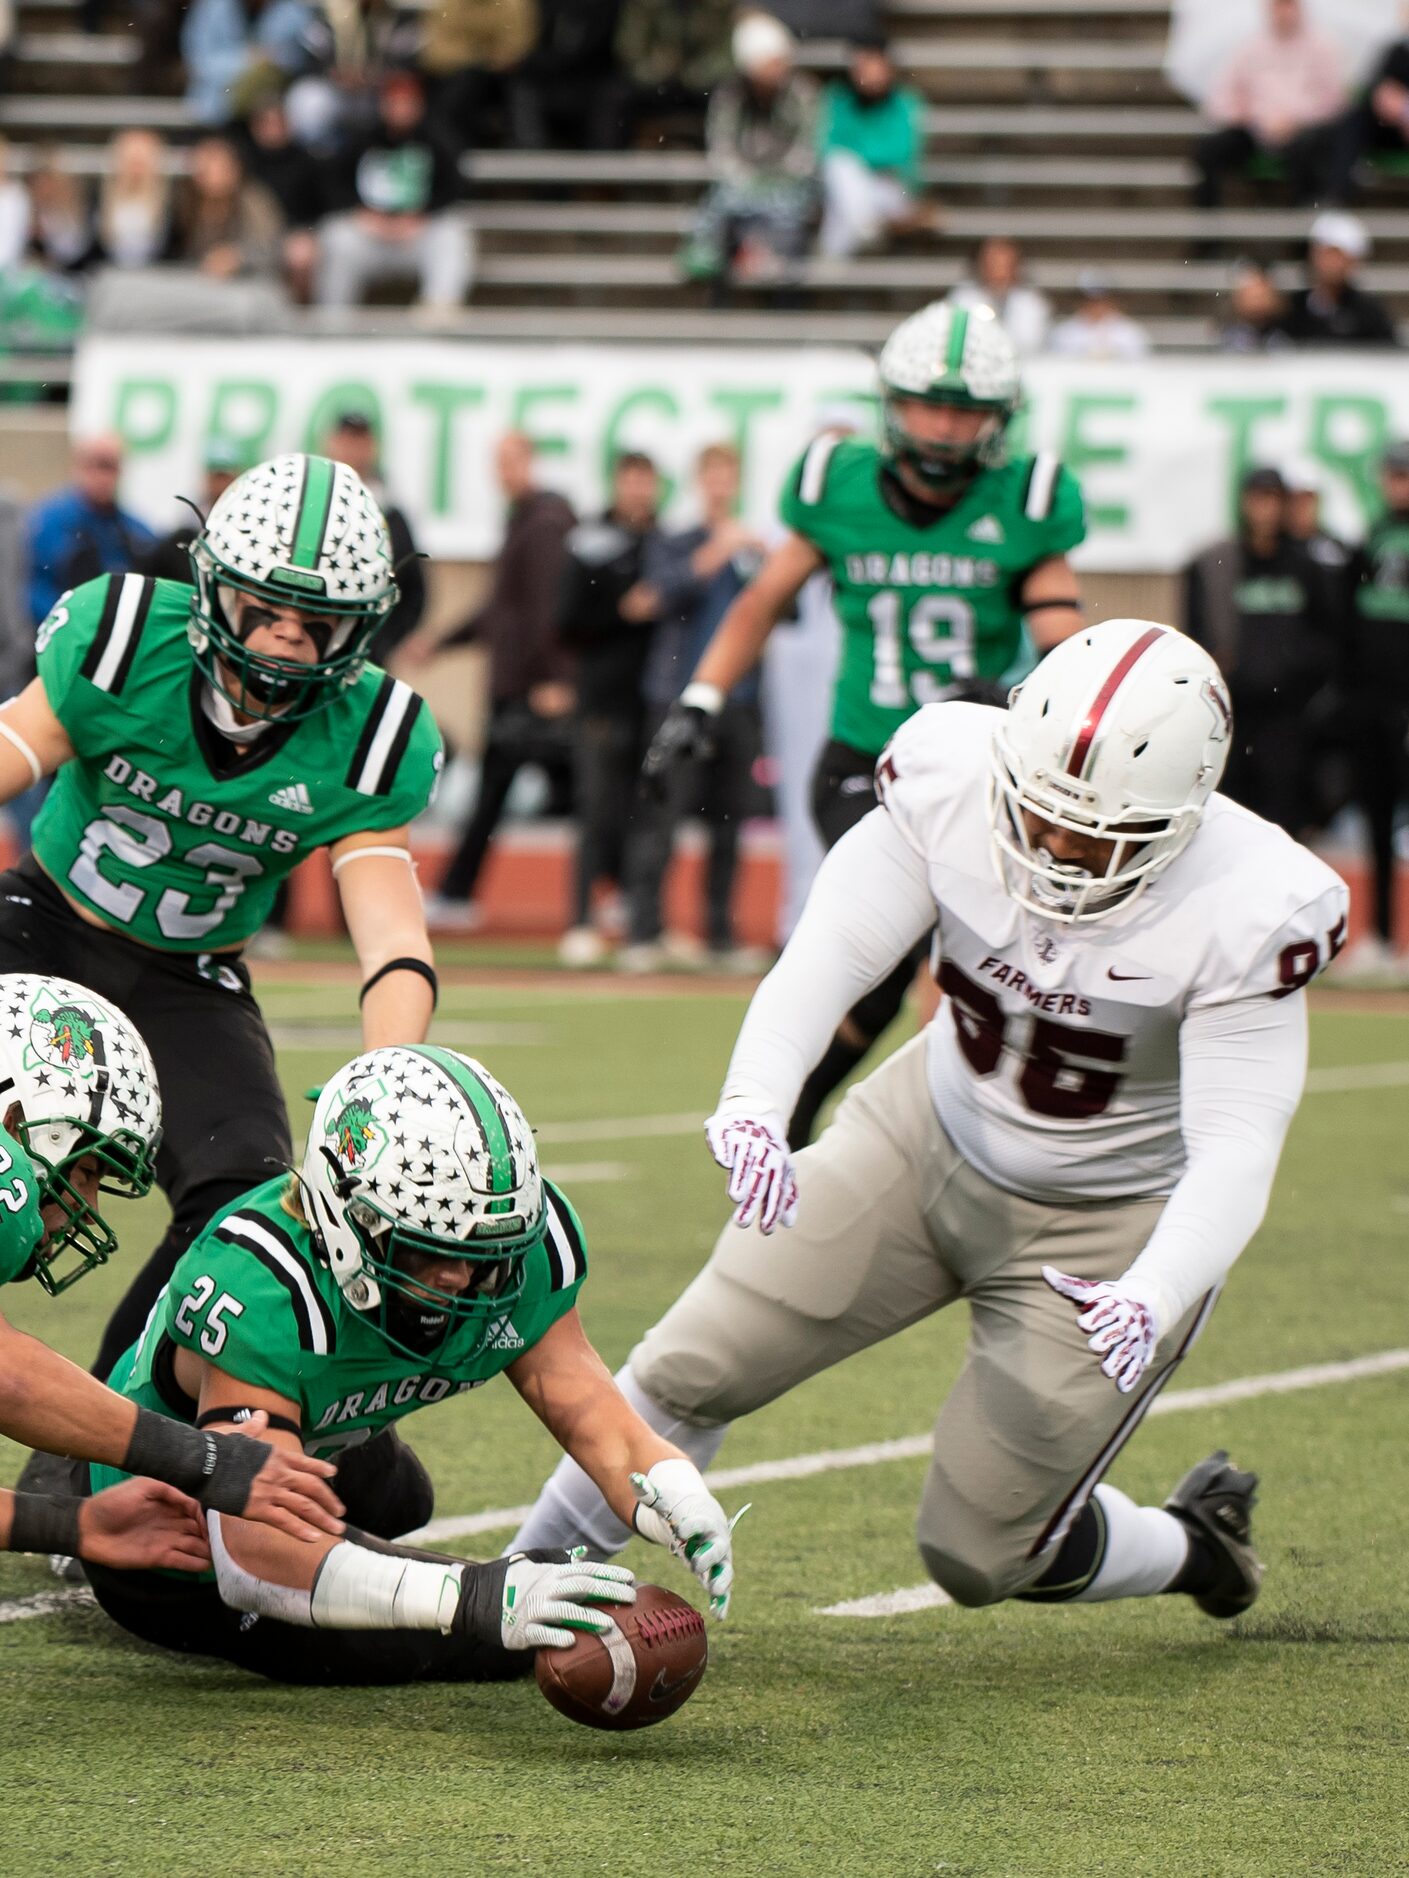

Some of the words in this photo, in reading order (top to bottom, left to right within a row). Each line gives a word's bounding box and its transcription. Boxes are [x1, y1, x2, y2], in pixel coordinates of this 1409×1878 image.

[845, 551, 1000, 588] DRAGONS
[866, 588, 978, 710] 19
[102, 753, 300, 854] DRAGONS
[67, 803, 266, 940] 23
[976, 956, 1093, 1017] FARMERS
[174, 1274, 246, 1357] 25
